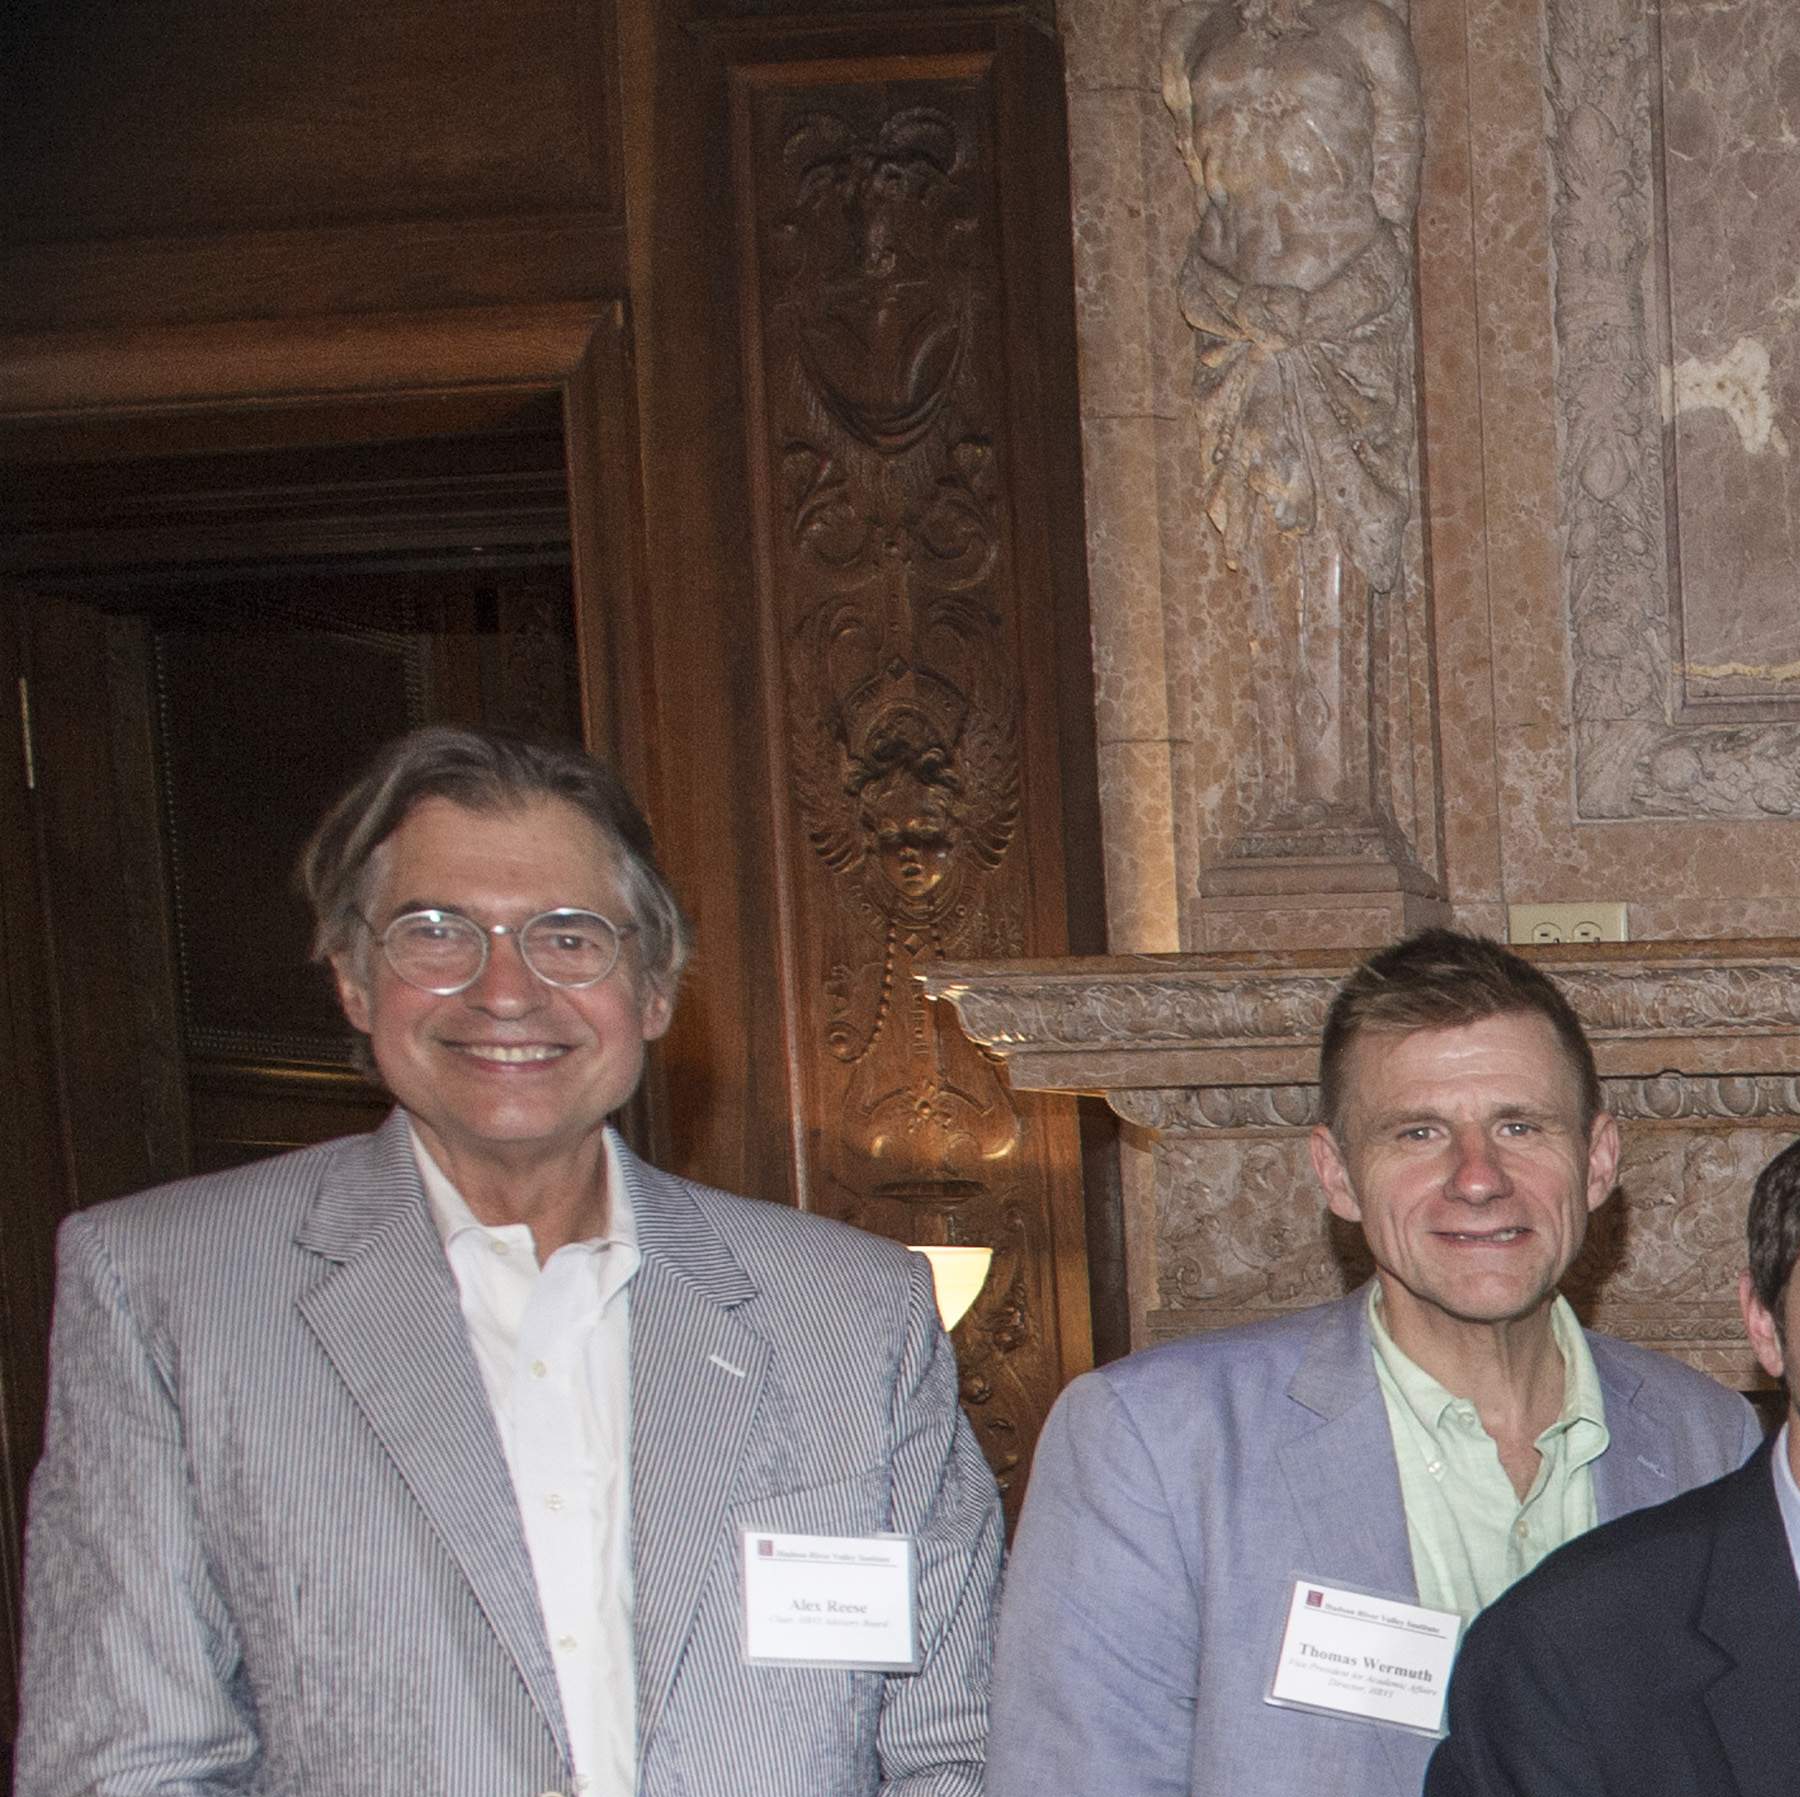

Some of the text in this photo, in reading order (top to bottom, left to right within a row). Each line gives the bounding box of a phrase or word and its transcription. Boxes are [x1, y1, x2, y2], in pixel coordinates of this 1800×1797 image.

[791, 1599, 868, 1613] Alex Reese
[1300, 1643, 1434, 1683] Thomas Wermuth
